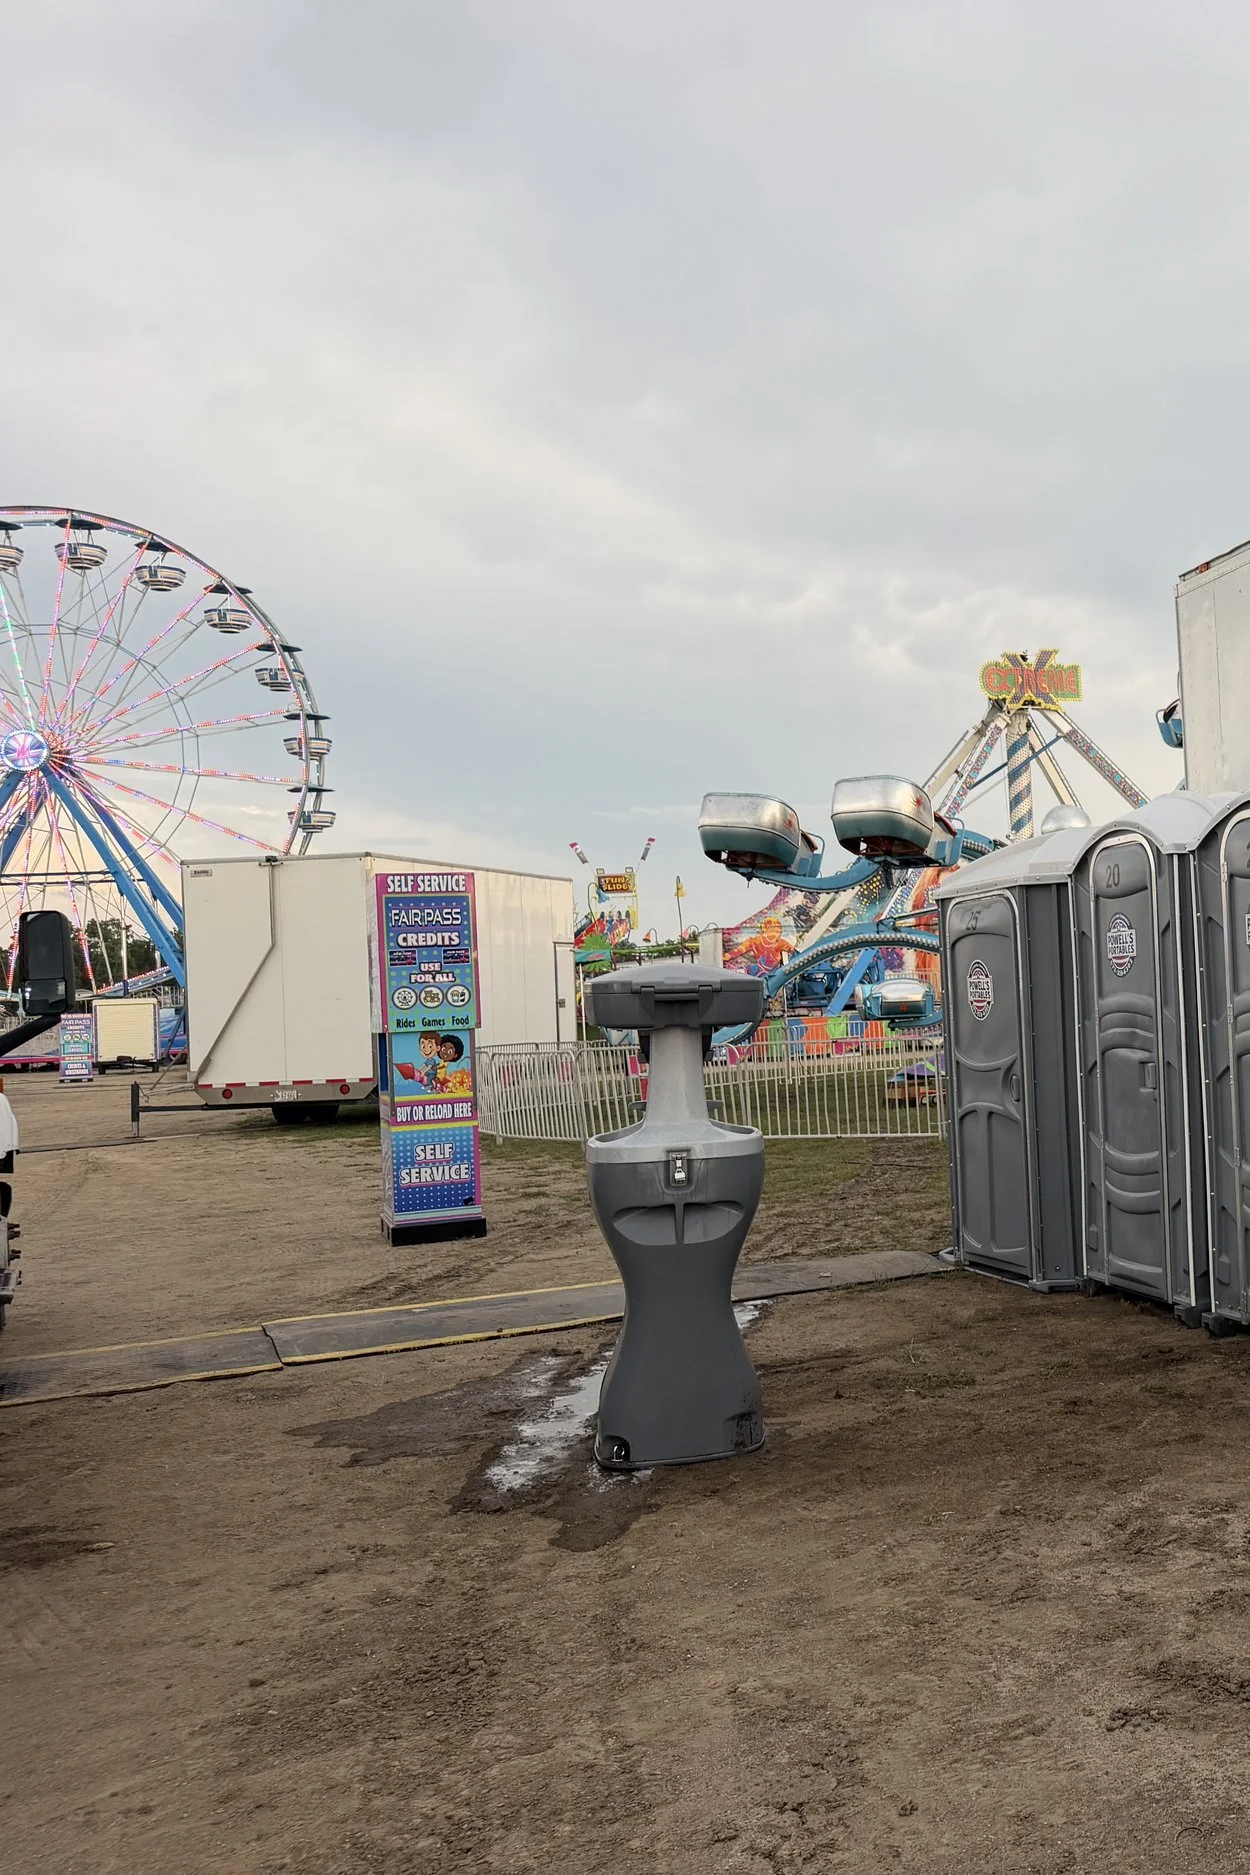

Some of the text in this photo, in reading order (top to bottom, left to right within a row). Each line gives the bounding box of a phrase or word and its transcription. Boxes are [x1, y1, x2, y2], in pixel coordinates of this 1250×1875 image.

[386, 875, 466, 893] SELF SERVICE
[1105, 863, 1120, 889] 20
[391, 908, 462, 927] FAIR PASS
[965, 910, 982, 931] 25
[397, 931, 460, 947] CREDITS
[1107, 932, 1134, 946] POWELL'S
[1108, 944, 1135, 955] PORTABLES
[420, 962, 442, 972] USE
[410, 972, 455, 983] FOR ALL
[969, 980, 990, 991] POWELL'S
[396, 1015, 469, 1028] Rides Games Food
[396, 1102, 472, 1123] BUY OR RELOAD HERE
[415, 1143, 454, 1161] SELF
[400, 1163, 470, 1185] SERVICE
